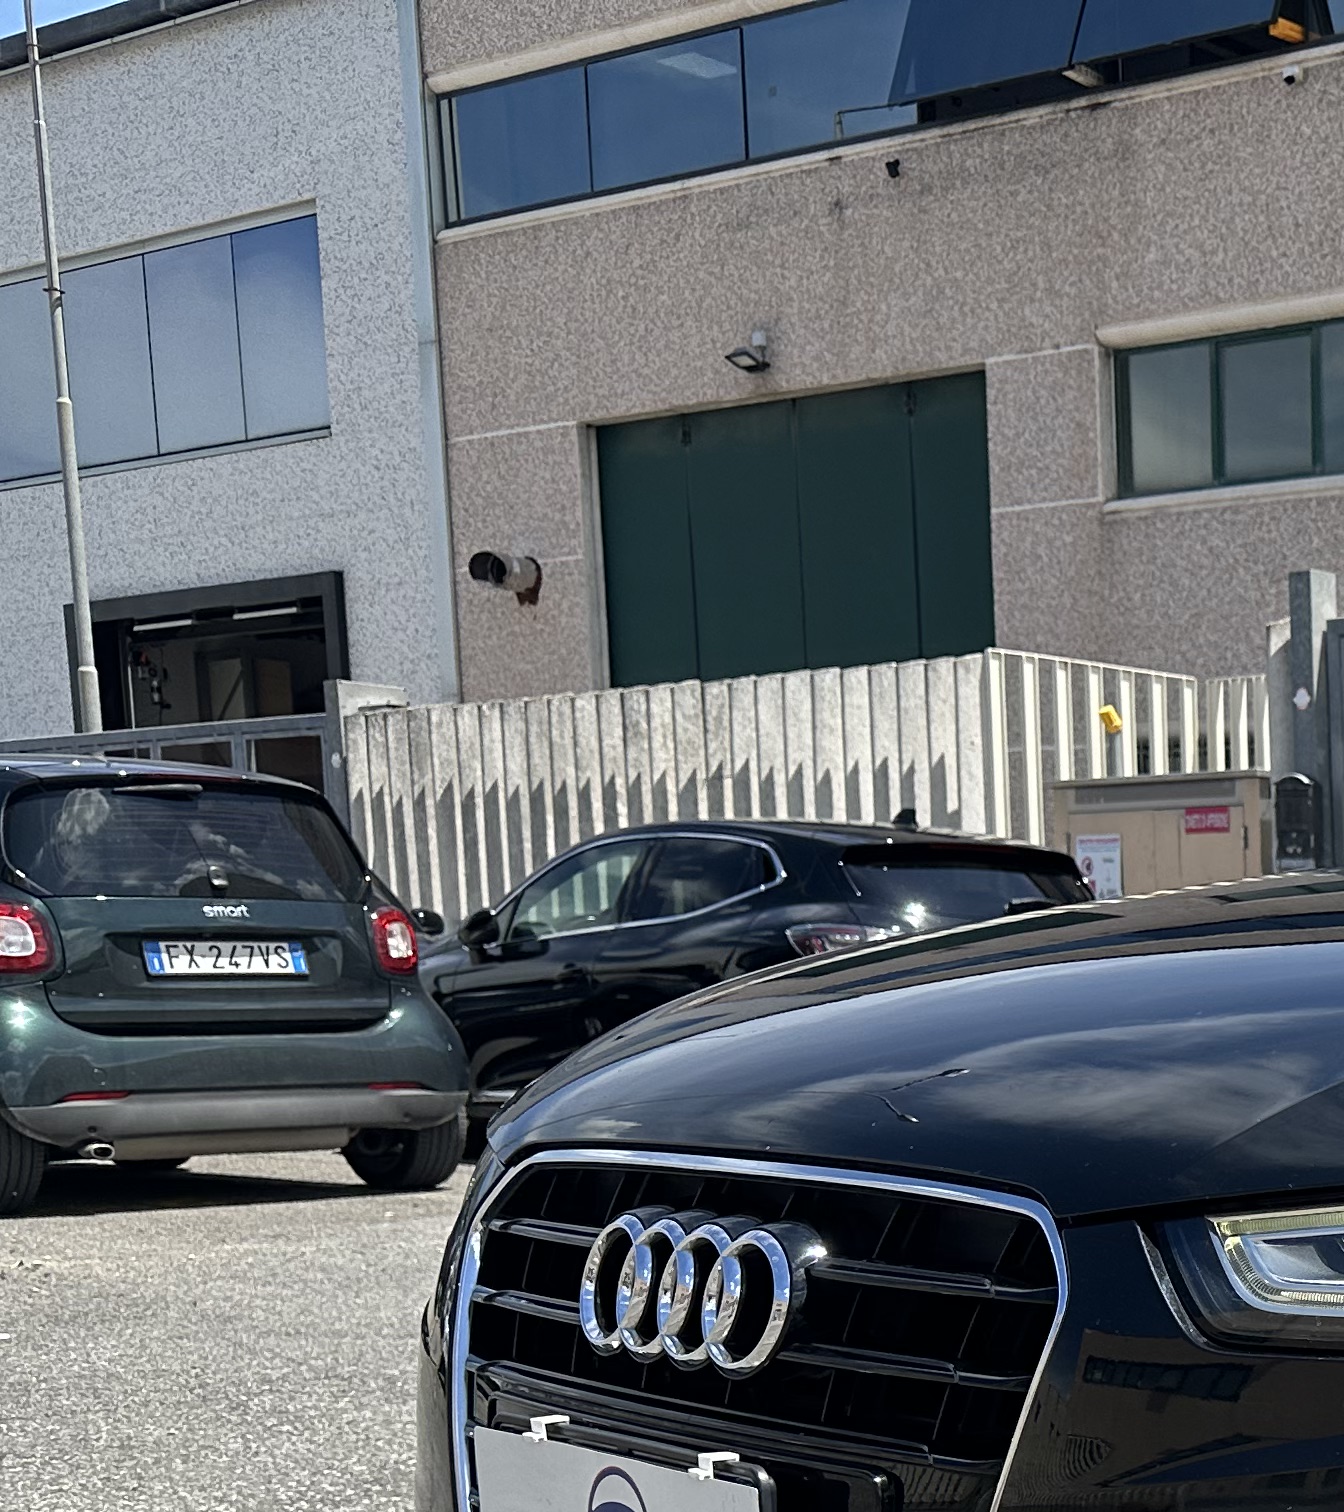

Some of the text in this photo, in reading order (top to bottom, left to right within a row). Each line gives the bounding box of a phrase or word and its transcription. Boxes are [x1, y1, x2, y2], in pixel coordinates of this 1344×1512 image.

[202, 904, 250, 918] smart
[165, 944, 289, 969] FX 247VS
